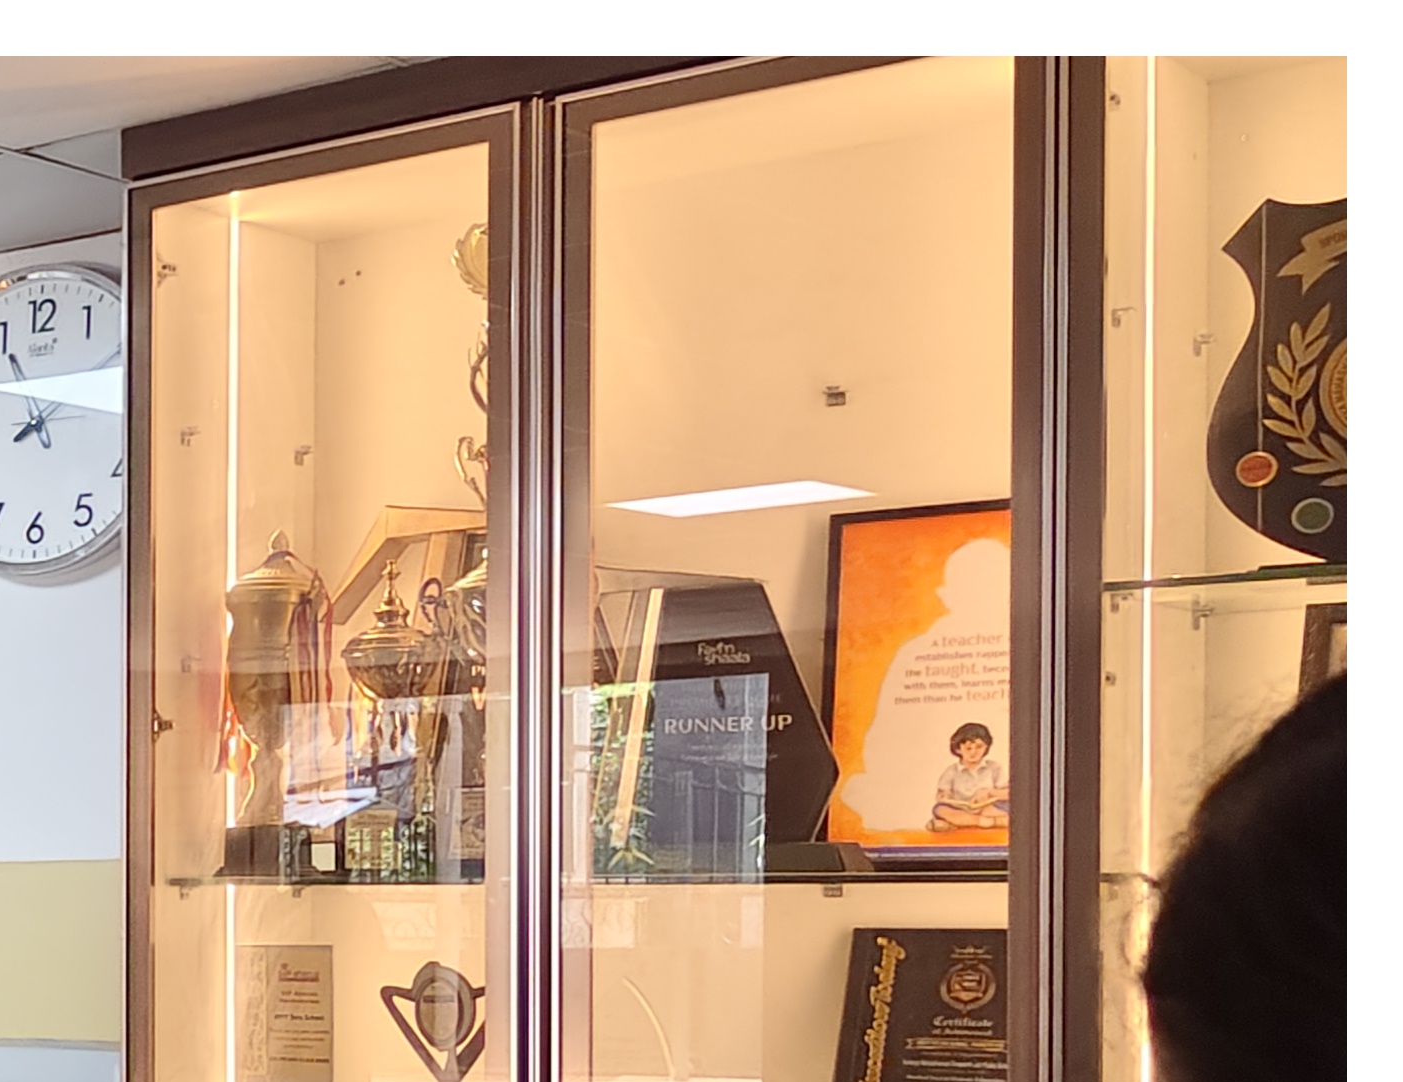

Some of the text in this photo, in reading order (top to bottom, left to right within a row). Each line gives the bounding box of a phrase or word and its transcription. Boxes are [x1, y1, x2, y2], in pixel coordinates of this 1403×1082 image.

[28, 298, 57, 334] 12
[82, 305, 92, 340] 1
[73, 493, 93, 527] 5
[26, 511, 44, 544] 6
[942, 633, 1003, 648] teacher
[905, 669, 922, 678] the
[664, 714, 793, 734] RUNNER UP
[933, 1015, 994, 1028] Certificate
